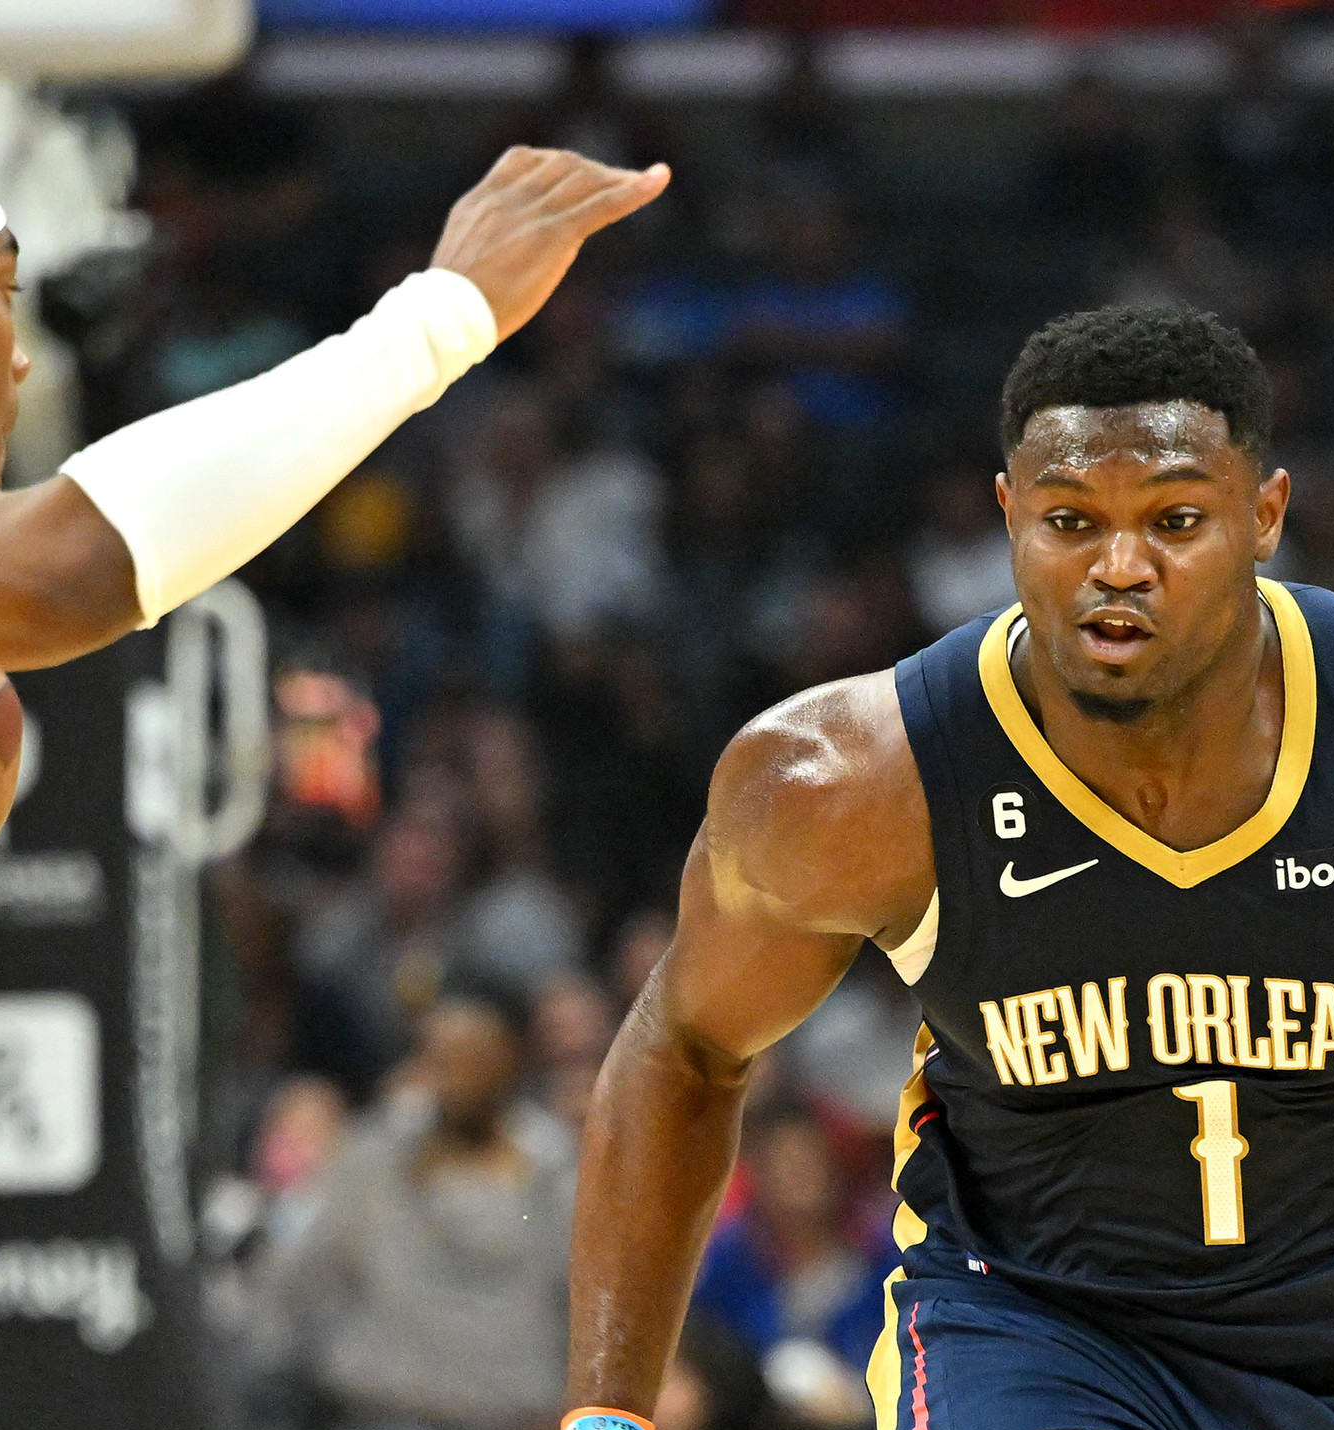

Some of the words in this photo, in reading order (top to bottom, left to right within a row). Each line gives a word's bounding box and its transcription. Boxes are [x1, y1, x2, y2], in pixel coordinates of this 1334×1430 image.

[992, 792, 1026, 838] 6
[979, 976, 1130, 1086] NEW
[1172, 1079, 1250, 1246] 1
